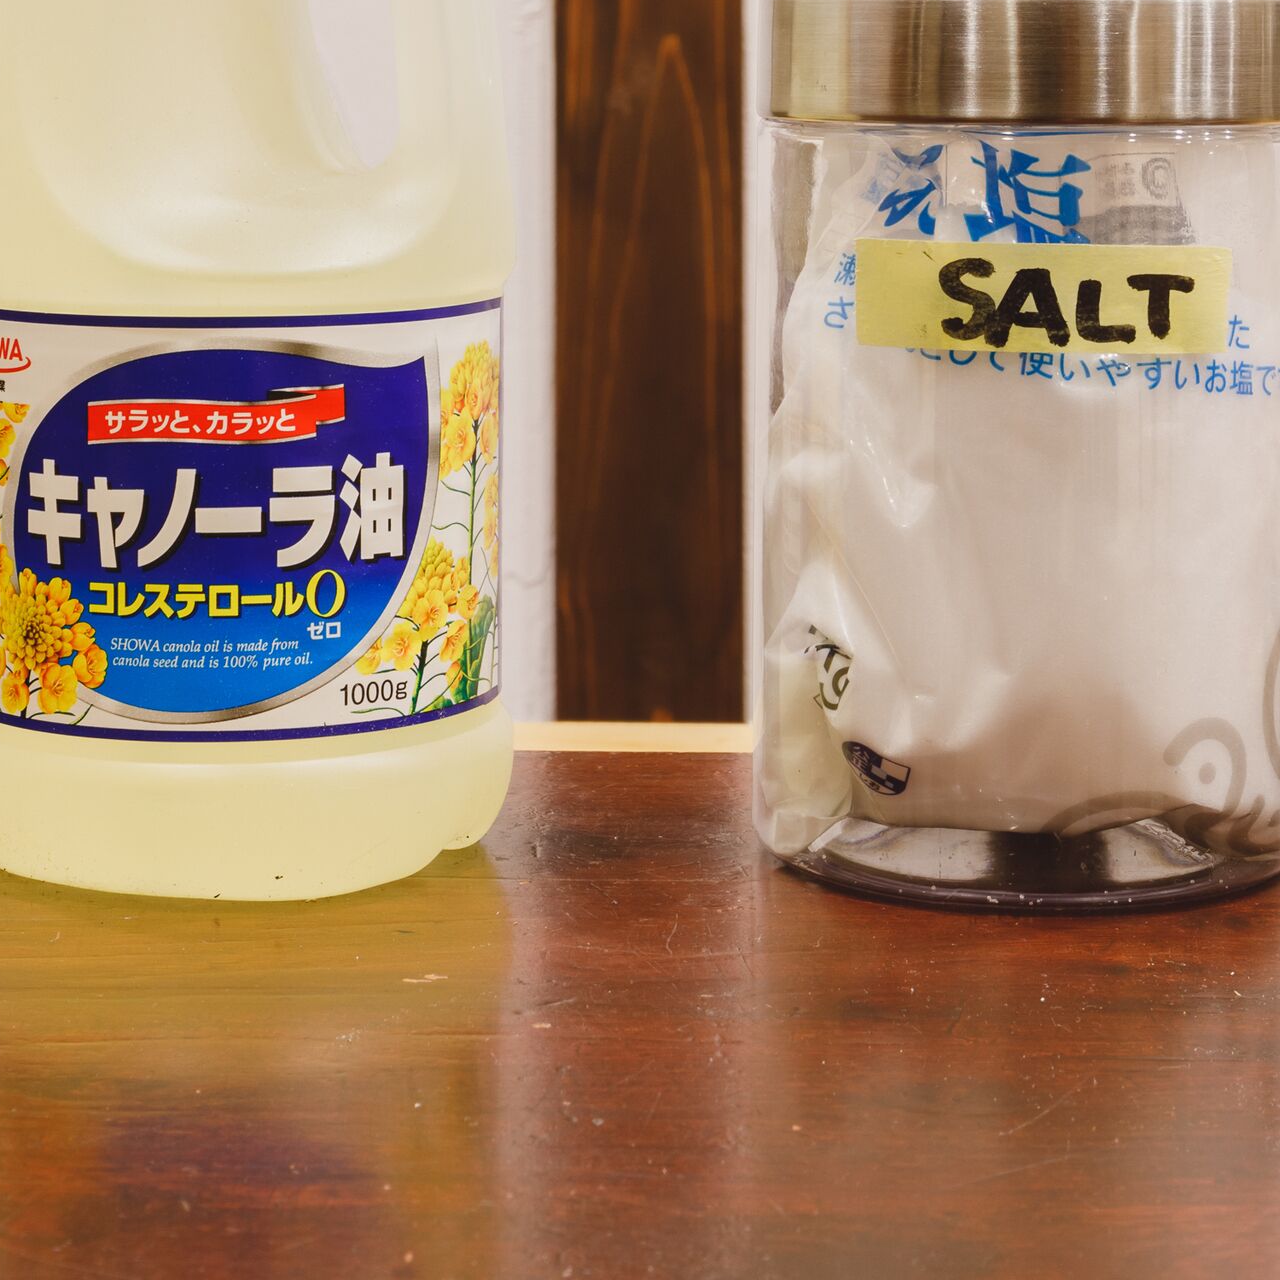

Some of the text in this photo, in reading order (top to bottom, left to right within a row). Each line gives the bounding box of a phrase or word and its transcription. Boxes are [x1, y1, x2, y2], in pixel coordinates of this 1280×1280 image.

[938, 257, 1194, 348] SALT
[104, 407, 297, 436] サラッと、カラッと
[27, 452, 405, 568] キャノーラ油
[306, 621, 342, 640] ゼロ
[110, 637, 299, 655] SHOWA canola oil is made from
[112, 651, 314, 671] canola seed and is 100% pure oil.
[339, 678, 408, 707] 1000g
